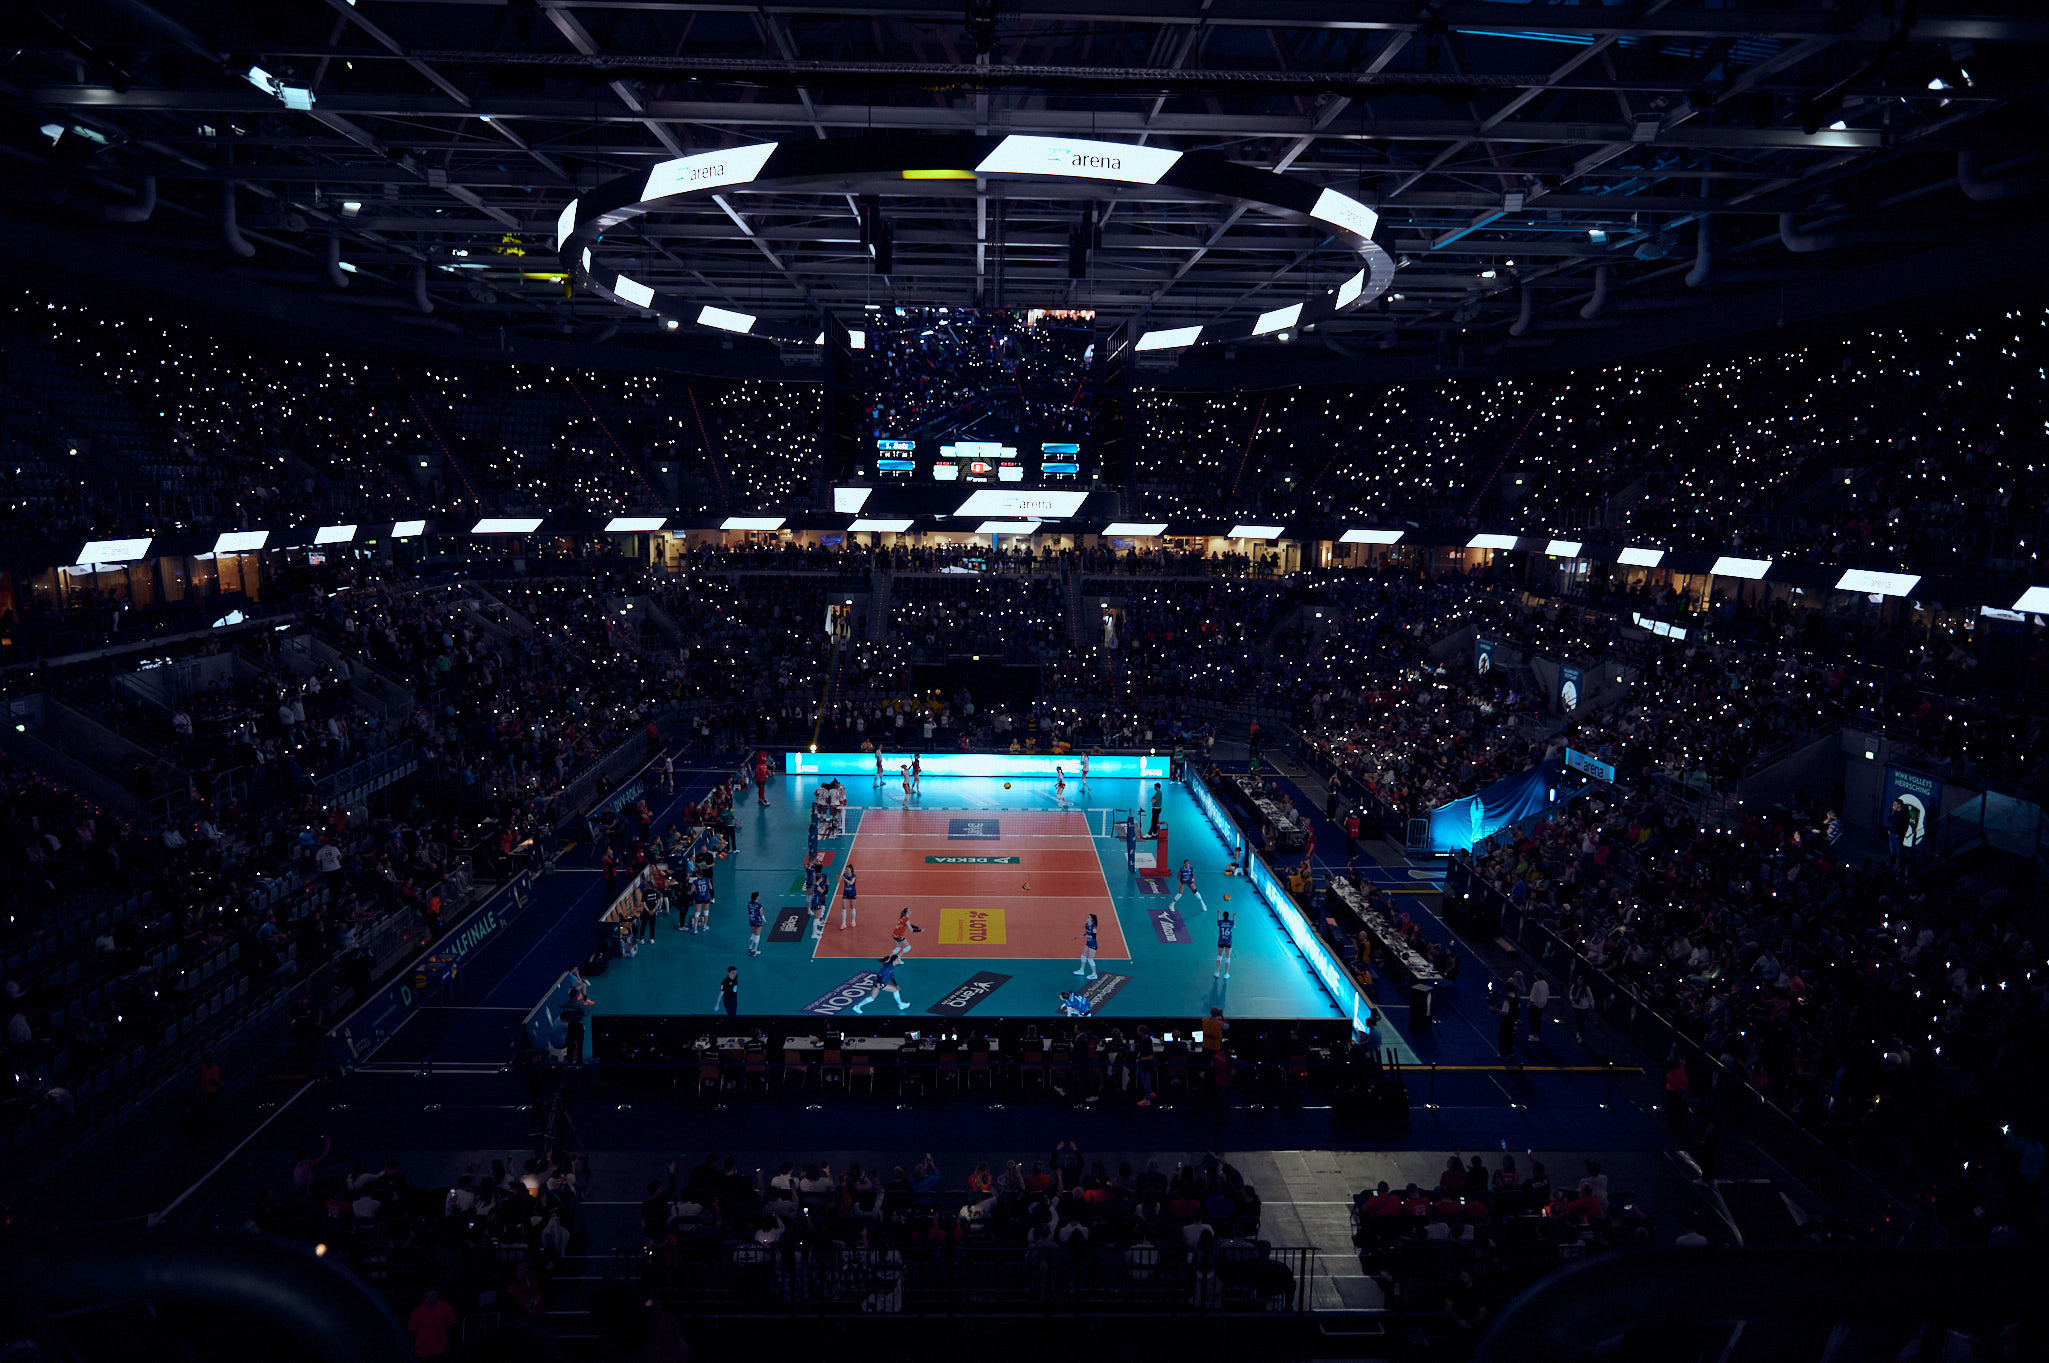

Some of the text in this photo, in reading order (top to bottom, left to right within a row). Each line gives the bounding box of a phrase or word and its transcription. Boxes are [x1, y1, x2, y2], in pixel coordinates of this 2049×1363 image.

[1071, 153, 1122, 170] arena
[689, 163, 725, 181] arena
[1018, 498, 1052, 510] arena
[1583, 761, 1604, 778] arena
[1893, 770, 1933, 789] WWK VOLLEYS
[1893, 778, 1932, 796] HERRSCHING
[697, 884, 707, 893] 10
[968, 919, 988, 942] LOTTO
[1219, 926, 1232, 937] 16
